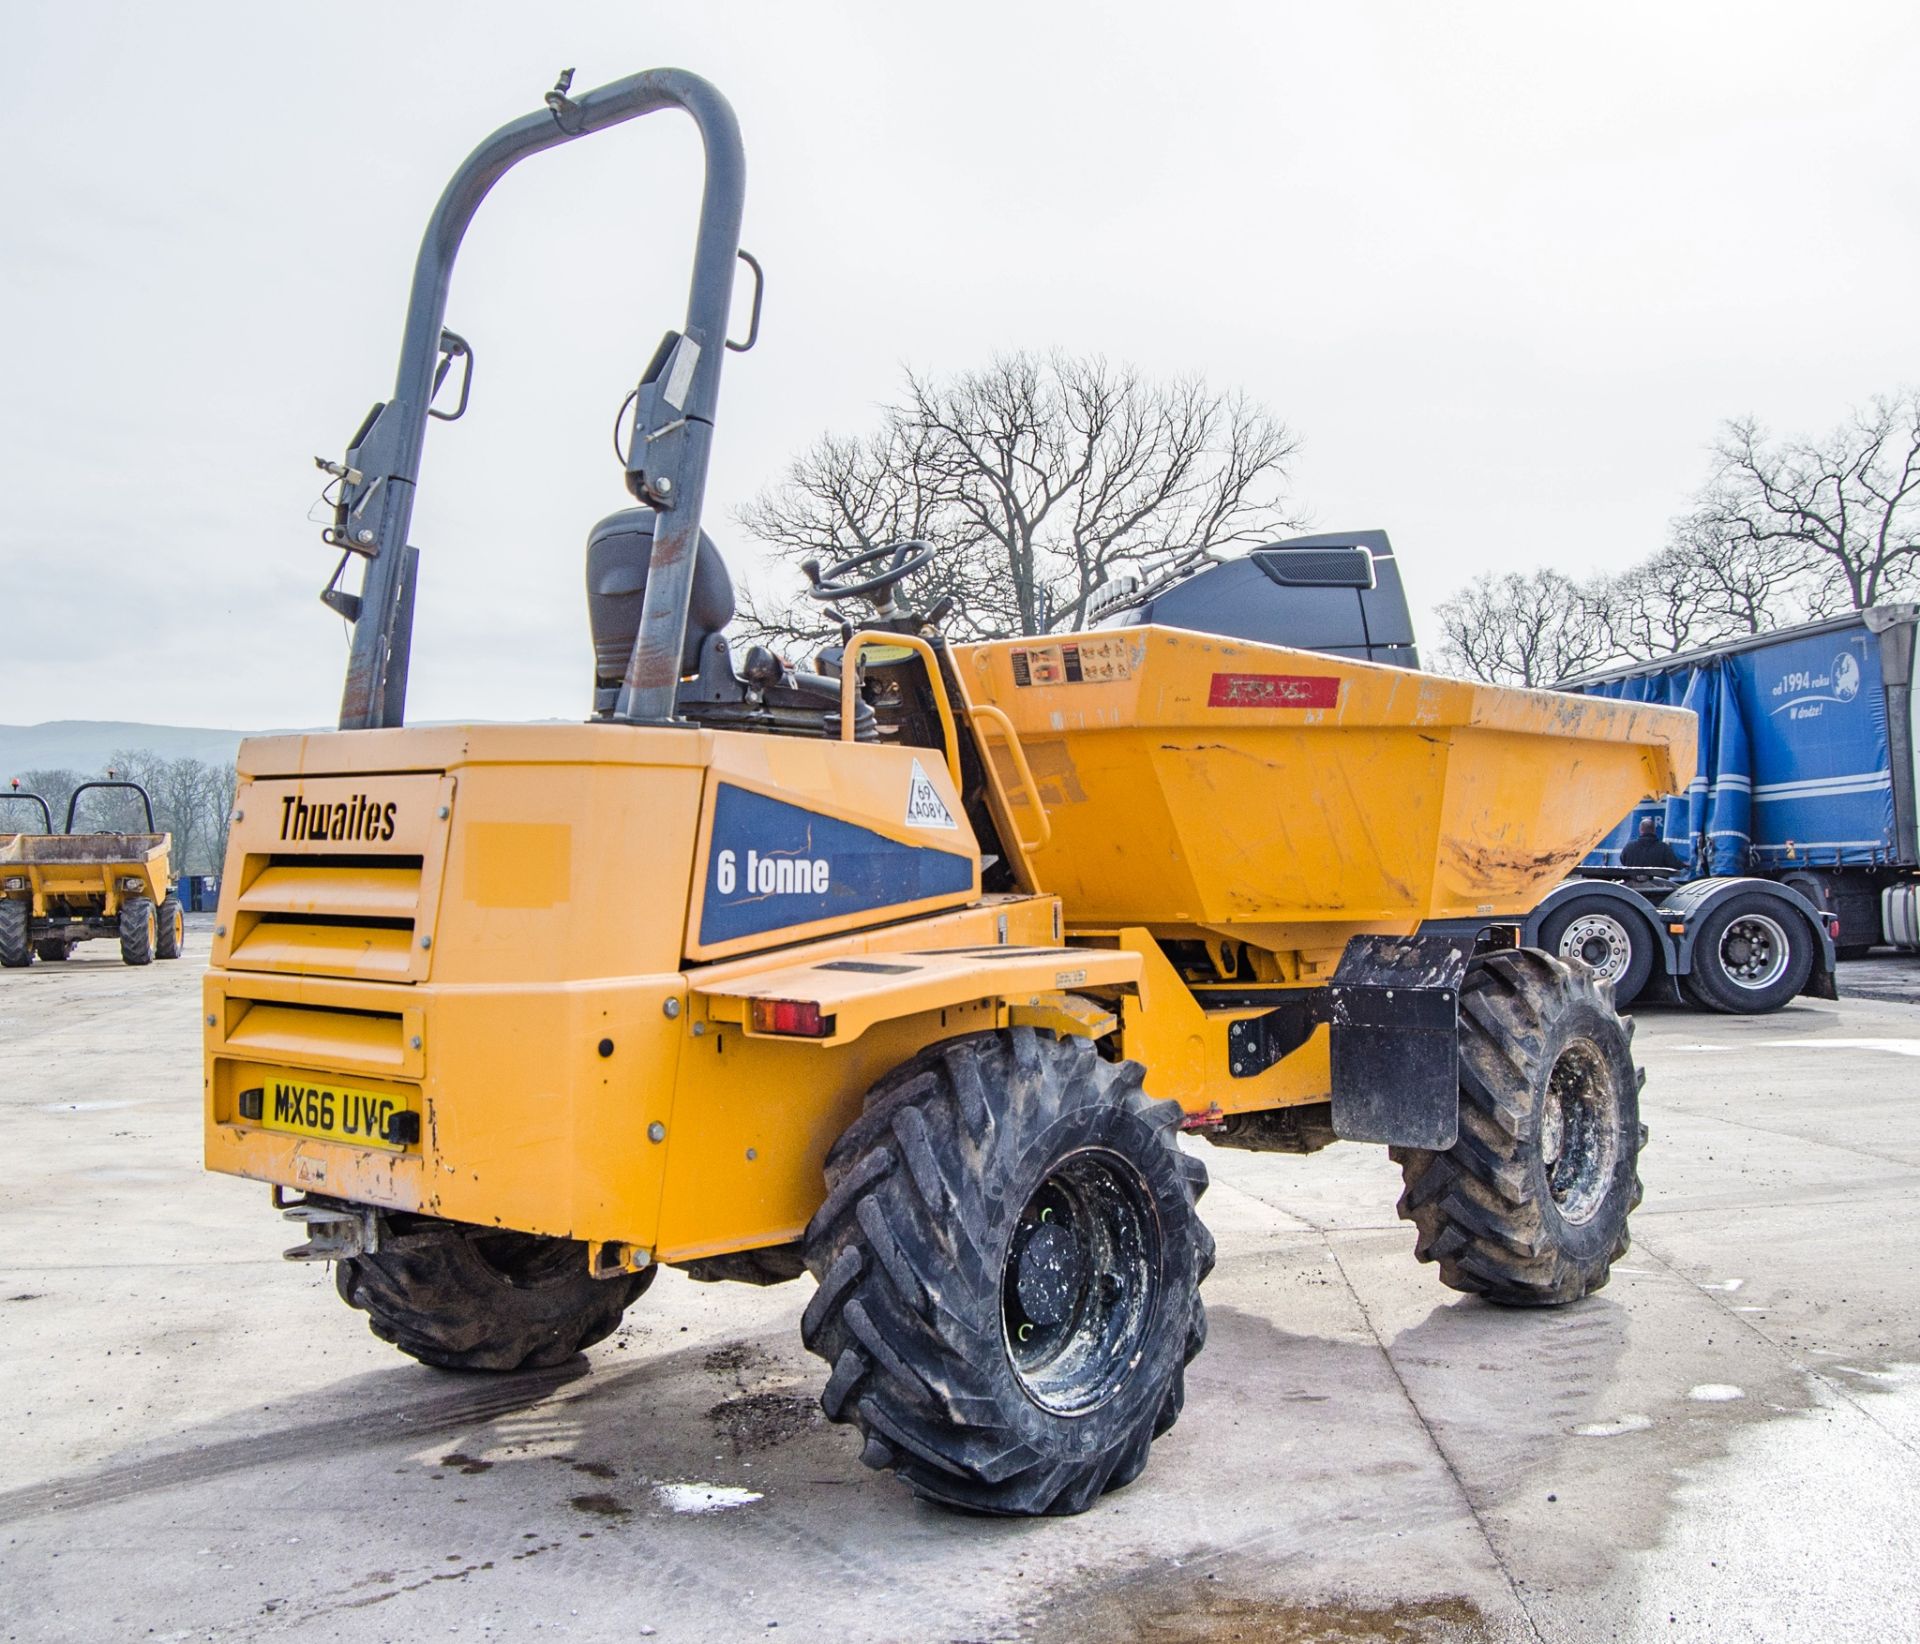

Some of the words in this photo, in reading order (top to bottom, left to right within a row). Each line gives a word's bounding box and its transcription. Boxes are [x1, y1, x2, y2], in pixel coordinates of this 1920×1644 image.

[1772, 681, 1782, 696] od
[1783, 671, 1810, 693] 1994
[1790, 707, 1798, 720] W
[917, 785, 931, 800] 69
[281, 794, 397, 841] Thwaites
[717, 849, 736, 895] 6
[747, 850, 829, 894] tonne
[274, 1084, 335, 1130] MX66
